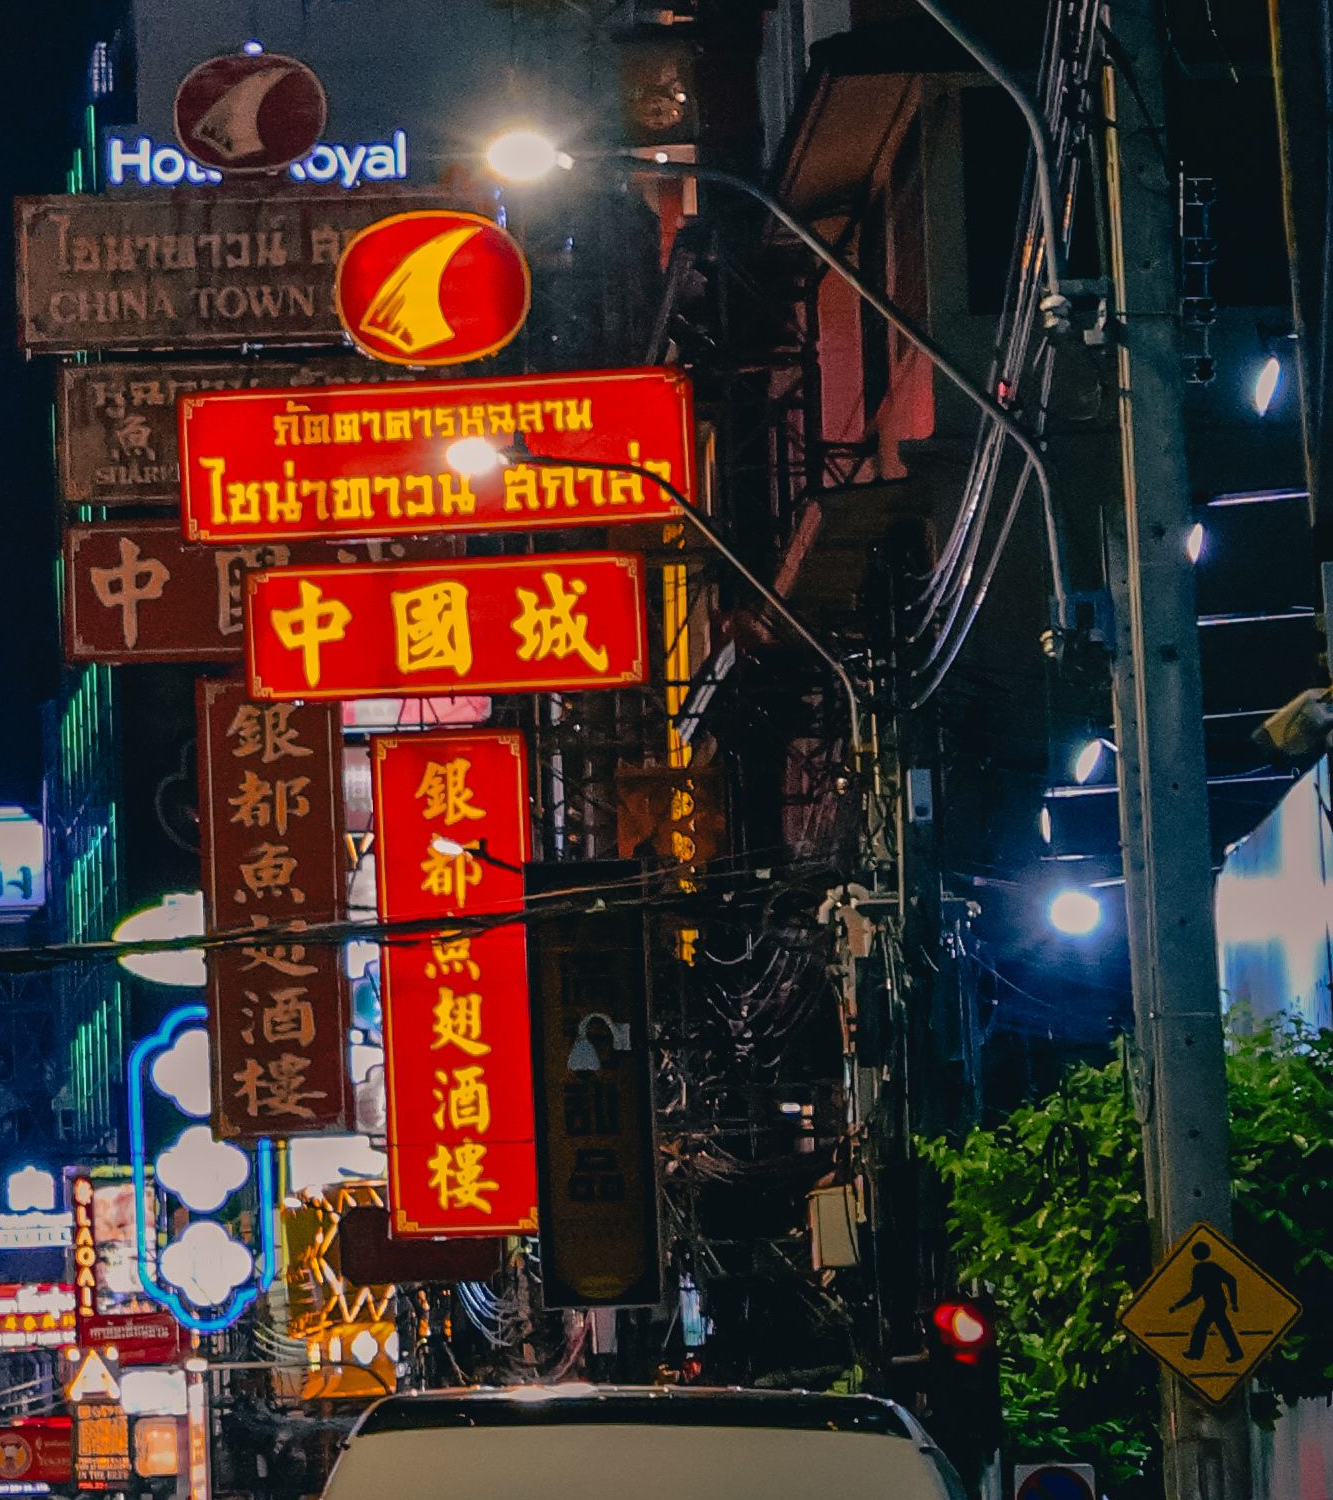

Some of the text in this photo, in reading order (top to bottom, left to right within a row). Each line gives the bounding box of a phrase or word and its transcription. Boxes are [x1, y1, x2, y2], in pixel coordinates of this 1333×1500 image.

[49, 285, 315, 323] CHINA TOWN
[274, 397, 593, 447] ภัตตาคารหฉลาม
[201, 456, 474, 527] ไชน่าทาวน
[271, 572, 609, 689] 中國城
